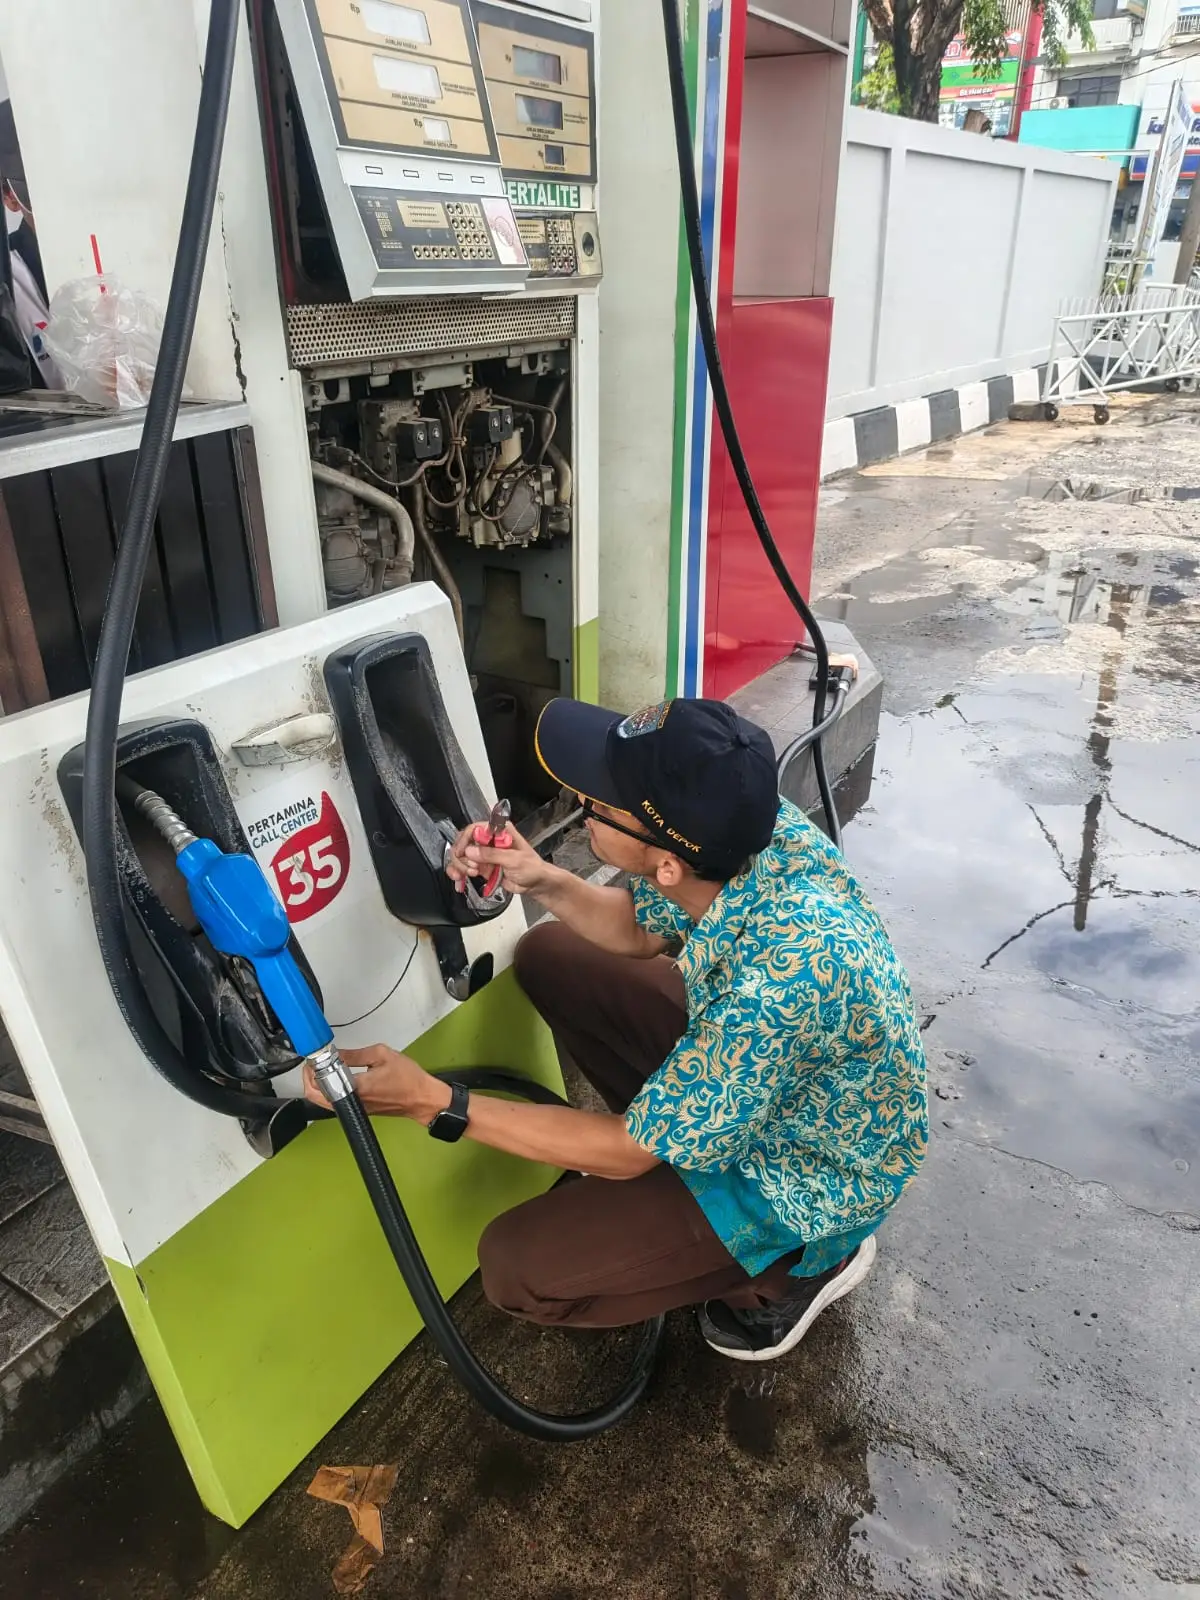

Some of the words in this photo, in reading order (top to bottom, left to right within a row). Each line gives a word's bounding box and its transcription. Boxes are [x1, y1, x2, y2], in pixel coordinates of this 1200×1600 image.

[505, 181, 580, 208] ERTALITE
[247, 796, 316, 837] PERTAMINA
[252, 826, 282, 849] CALL
[280, 808, 318, 834] CENTER
[641, 799, 665, 828] KOTA
[666, 827, 702, 853] DEPOK
